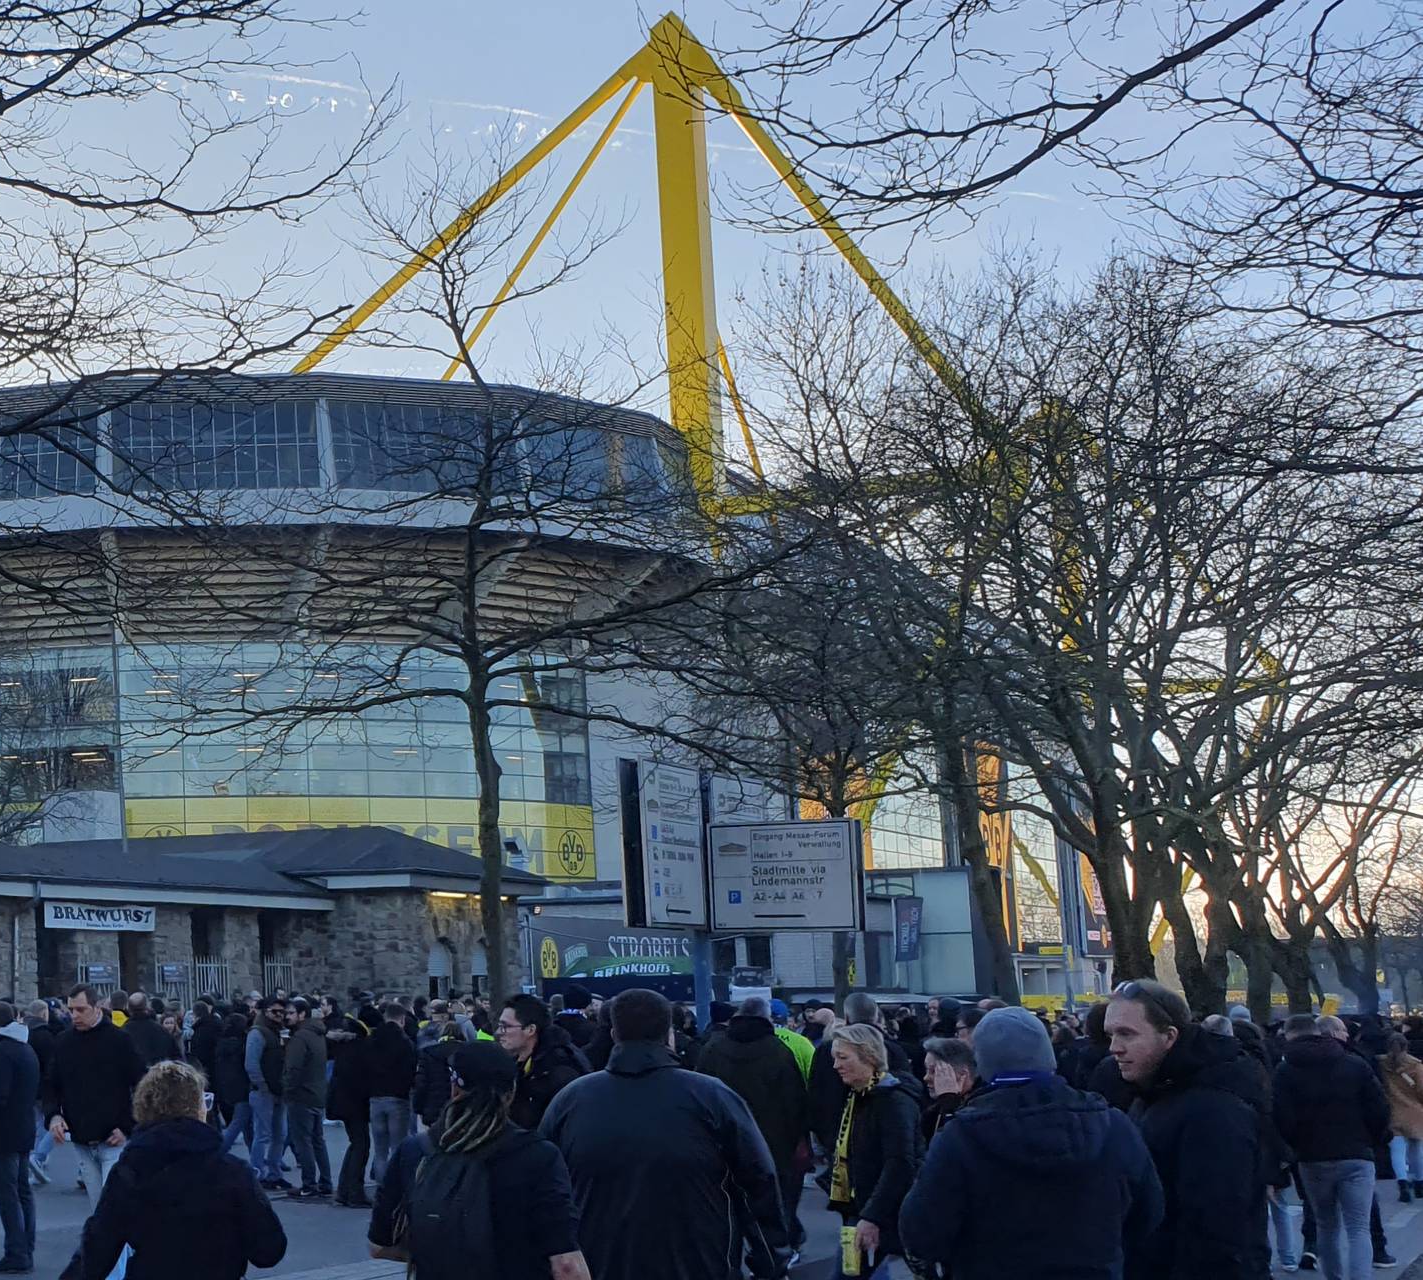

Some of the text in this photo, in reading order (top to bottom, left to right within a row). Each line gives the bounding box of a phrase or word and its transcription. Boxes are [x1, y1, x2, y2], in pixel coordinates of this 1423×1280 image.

[753, 831, 839, 841] Eingang Messe-Forum
[562, 834, 583, 861] BVB
[798, 841, 841, 849] Verwaltung
[752, 866, 826, 876] Stadtmitte via
[52, 905, 152, 924] BRATWURST
[543, 942, 557, 969] BVB
